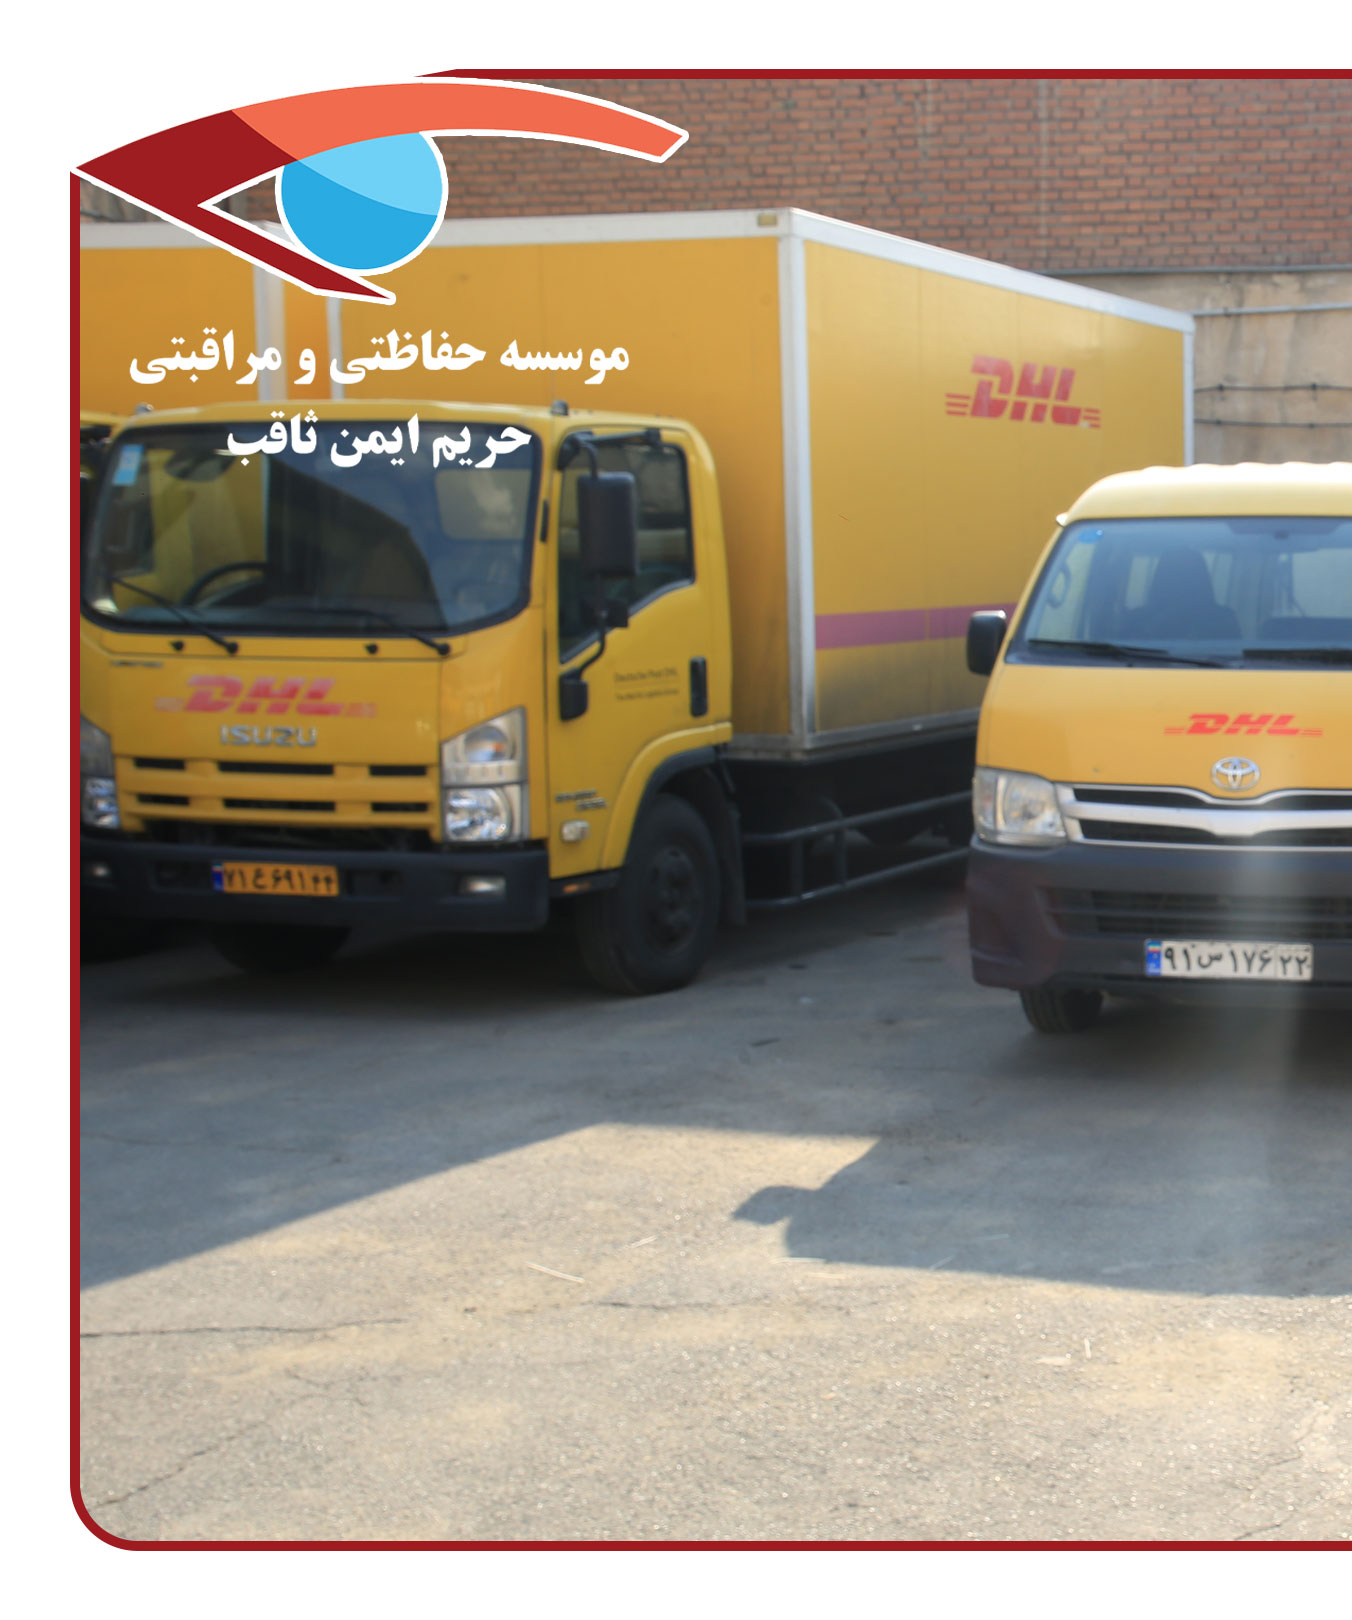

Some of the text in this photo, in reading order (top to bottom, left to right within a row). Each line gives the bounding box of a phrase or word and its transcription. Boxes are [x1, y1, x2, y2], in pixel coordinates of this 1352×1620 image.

[969, 353, 1082, 427] DHL
[184, 674, 346, 716] DHL
[219, 724, 318, 748] ISUZU
[1186, 713, 1300, 736] DHL
